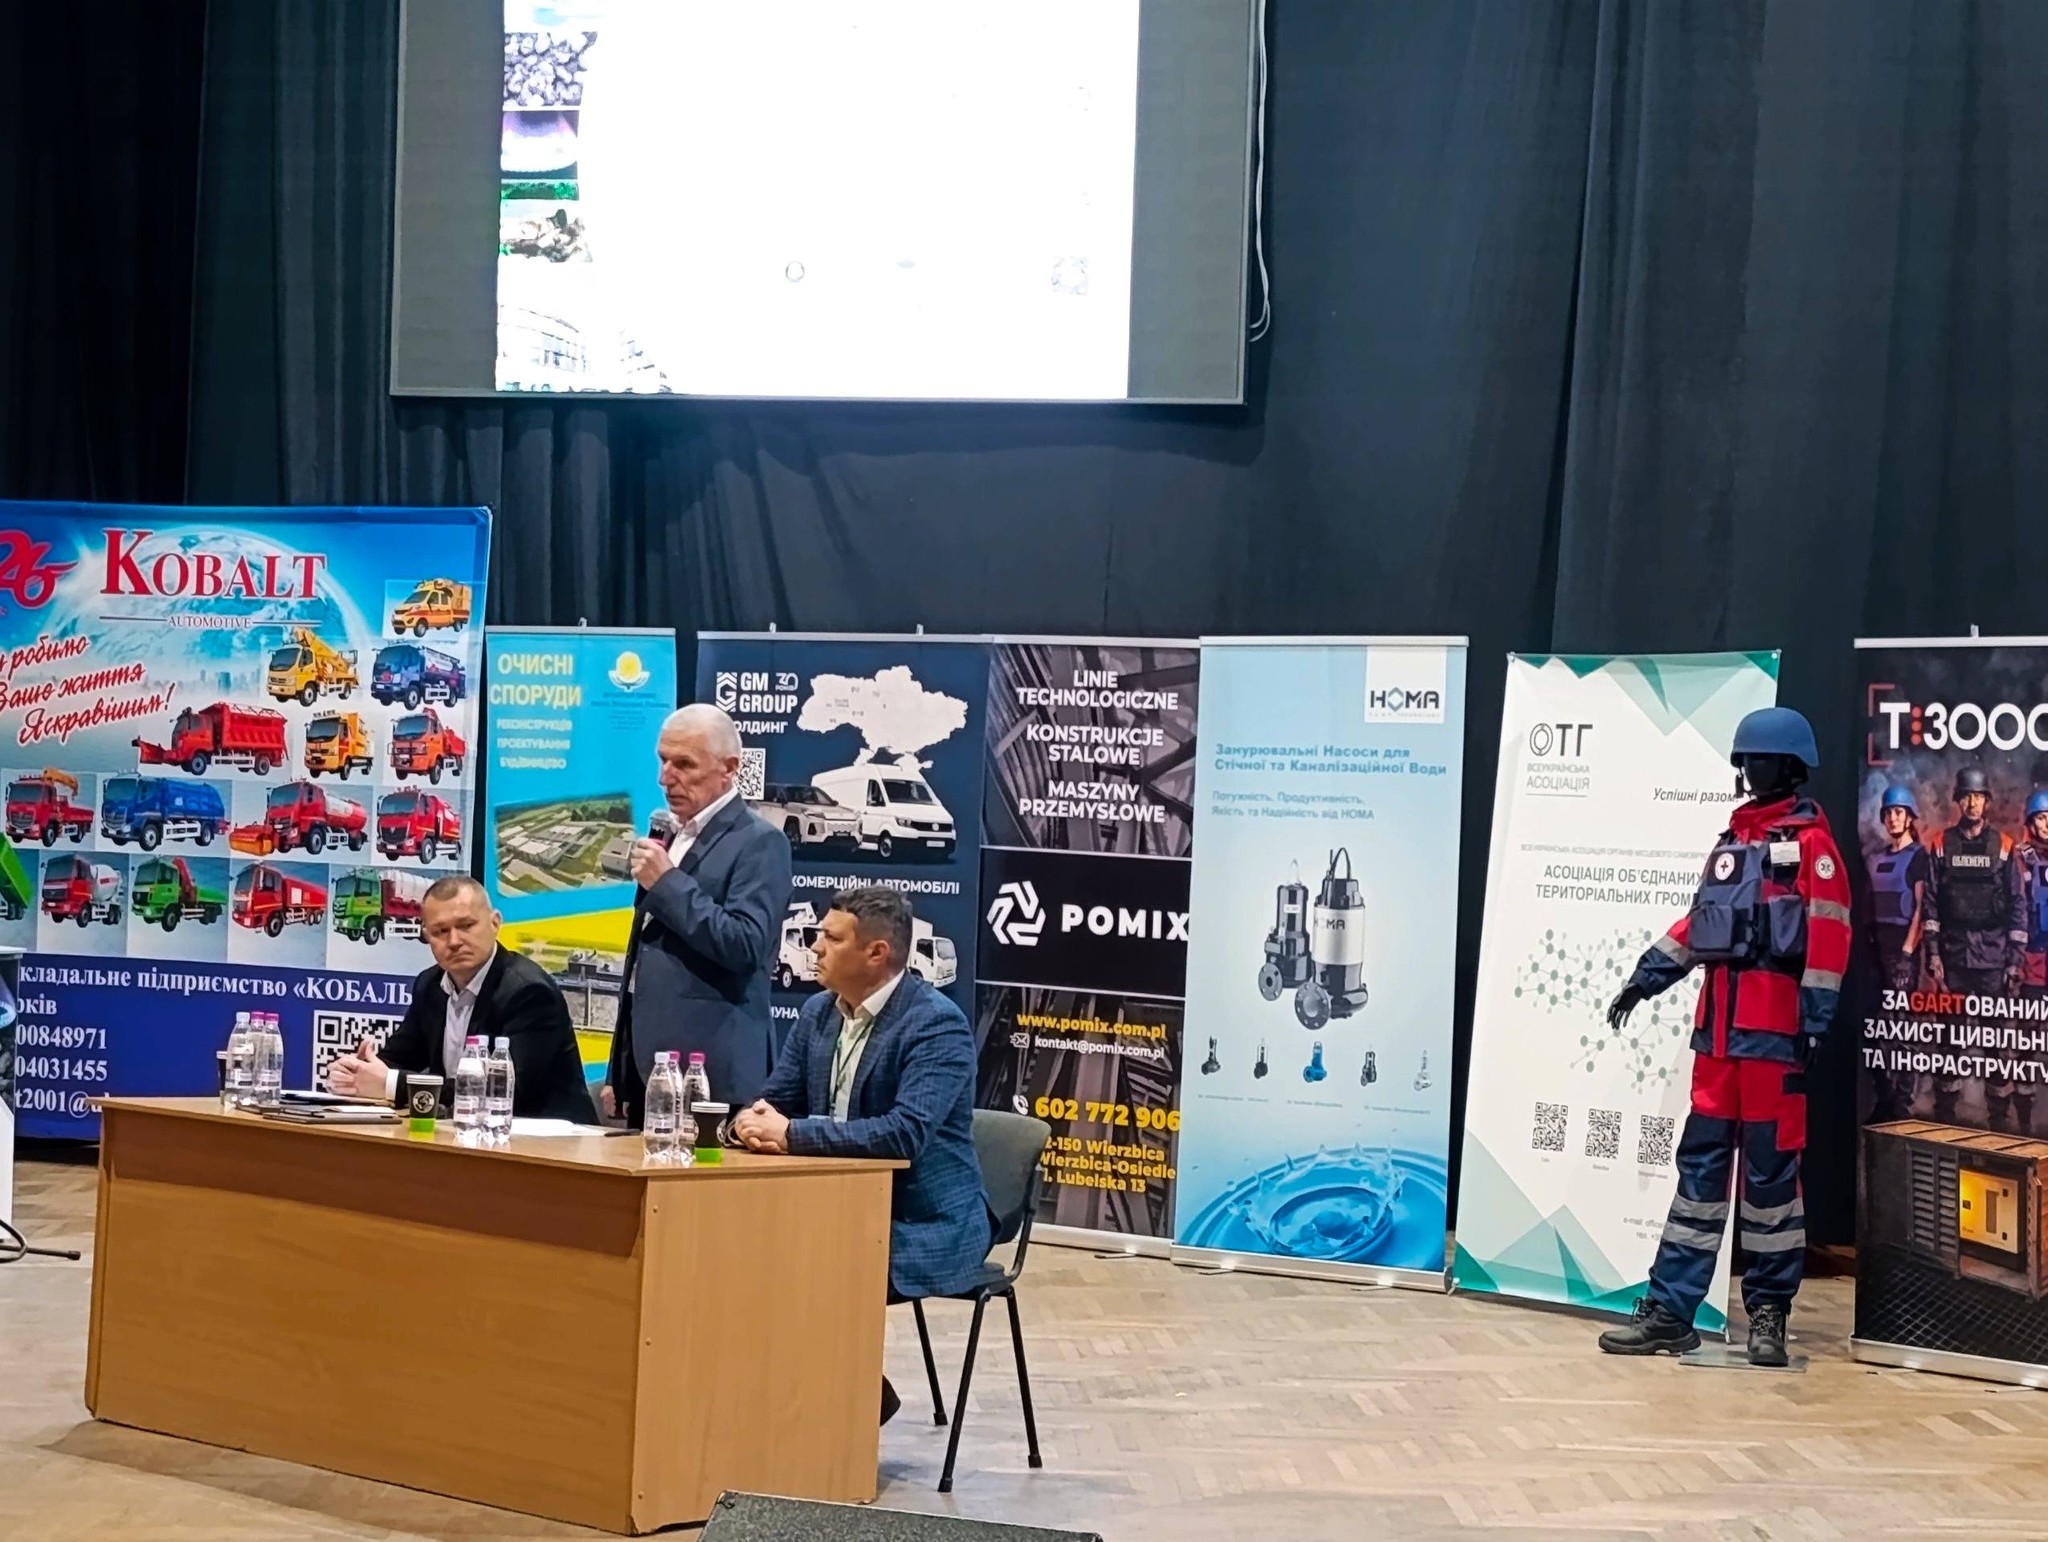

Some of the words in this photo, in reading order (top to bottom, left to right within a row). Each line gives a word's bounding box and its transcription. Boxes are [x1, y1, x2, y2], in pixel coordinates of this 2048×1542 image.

[168, 615, 251, 629] AUTOMOTIVE
[8, 634, 89, 681] робимо
[498, 653, 574, 675] ОЧИСНІ
[58, 662, 145, 698] життя
[740, 672, 769, 691] GM
[1073, 669, 1118, 688] LINIE
[490, 684, 582, 710] СПОРУДИ
[739, 694, 798, 714] GROUP
[1016, 687, 1178, 710] TECHNOLOGICZNE
[1370, 686, 1440, 712] HOMA
[19, 682, 176, 744] Яскравішим!
[1026, 723, 1165, 747] KONSTRUKCJE
[1529, 722, 1593, 757] ОТГ
[1048, 744, 1140, 766] STALOWE
[1215, 743, 1318, 759] Занурювальні
[1323, 744, 1378, 758] Насоси
[1383, 748, 1410, 760] для
[1214, 758, 1265, 770] Стічної
[1270, 761, 1285, 771] та
[1290, 760, 1404, 775] Каналізаційної
[1409, 762, 1447, 776] Води
[1048, 780, 1140, 802] MASZYNY
[1526, 775, 1590, 792] АСОЦІАЦІЯ
[1653, 786, 1698, 802] Успішні
[1019, 798, 1165, 823] PRZEMYSŁOWE
[1544, 864, 1615, 884] АСОЦІАЦІЯ
[1536, 884, 1650, 905] ТЕРИТОРІАЛЬНИХ
[1061, 903, 1190, 941] POMIX
[20, 966, 132, 986] кладальне
[137, 967, 287, 996] підприємство
[1017, 1013, 1166, 1040] www.pomix.com.pl
[1864, 1018, 1946, 1044] ЗАХИСТ
[1950, 1024, 2048, 1054] ЦИВІЛЬН
[1034, 1035, 1165, 1060] kontakt@pomix.com.pl
[1862, 1048, 1886, 1070] ТА
[15, 1087, 110, 1119] t2001@u
[1035, 1096, 1079, 1123] 602
[1086, 1100, 1129, 1127] 772
[1136, 1107, 1180, 1132] 906
[1086, 1139, 1165, 1162] Wierzbica
[1040, 1151, 1177, 1180] Wierzbica-Osiedle
[1056, 1170, 1127, 1191] Lubelska
[1130, 1178, 1146, 1193] 13
